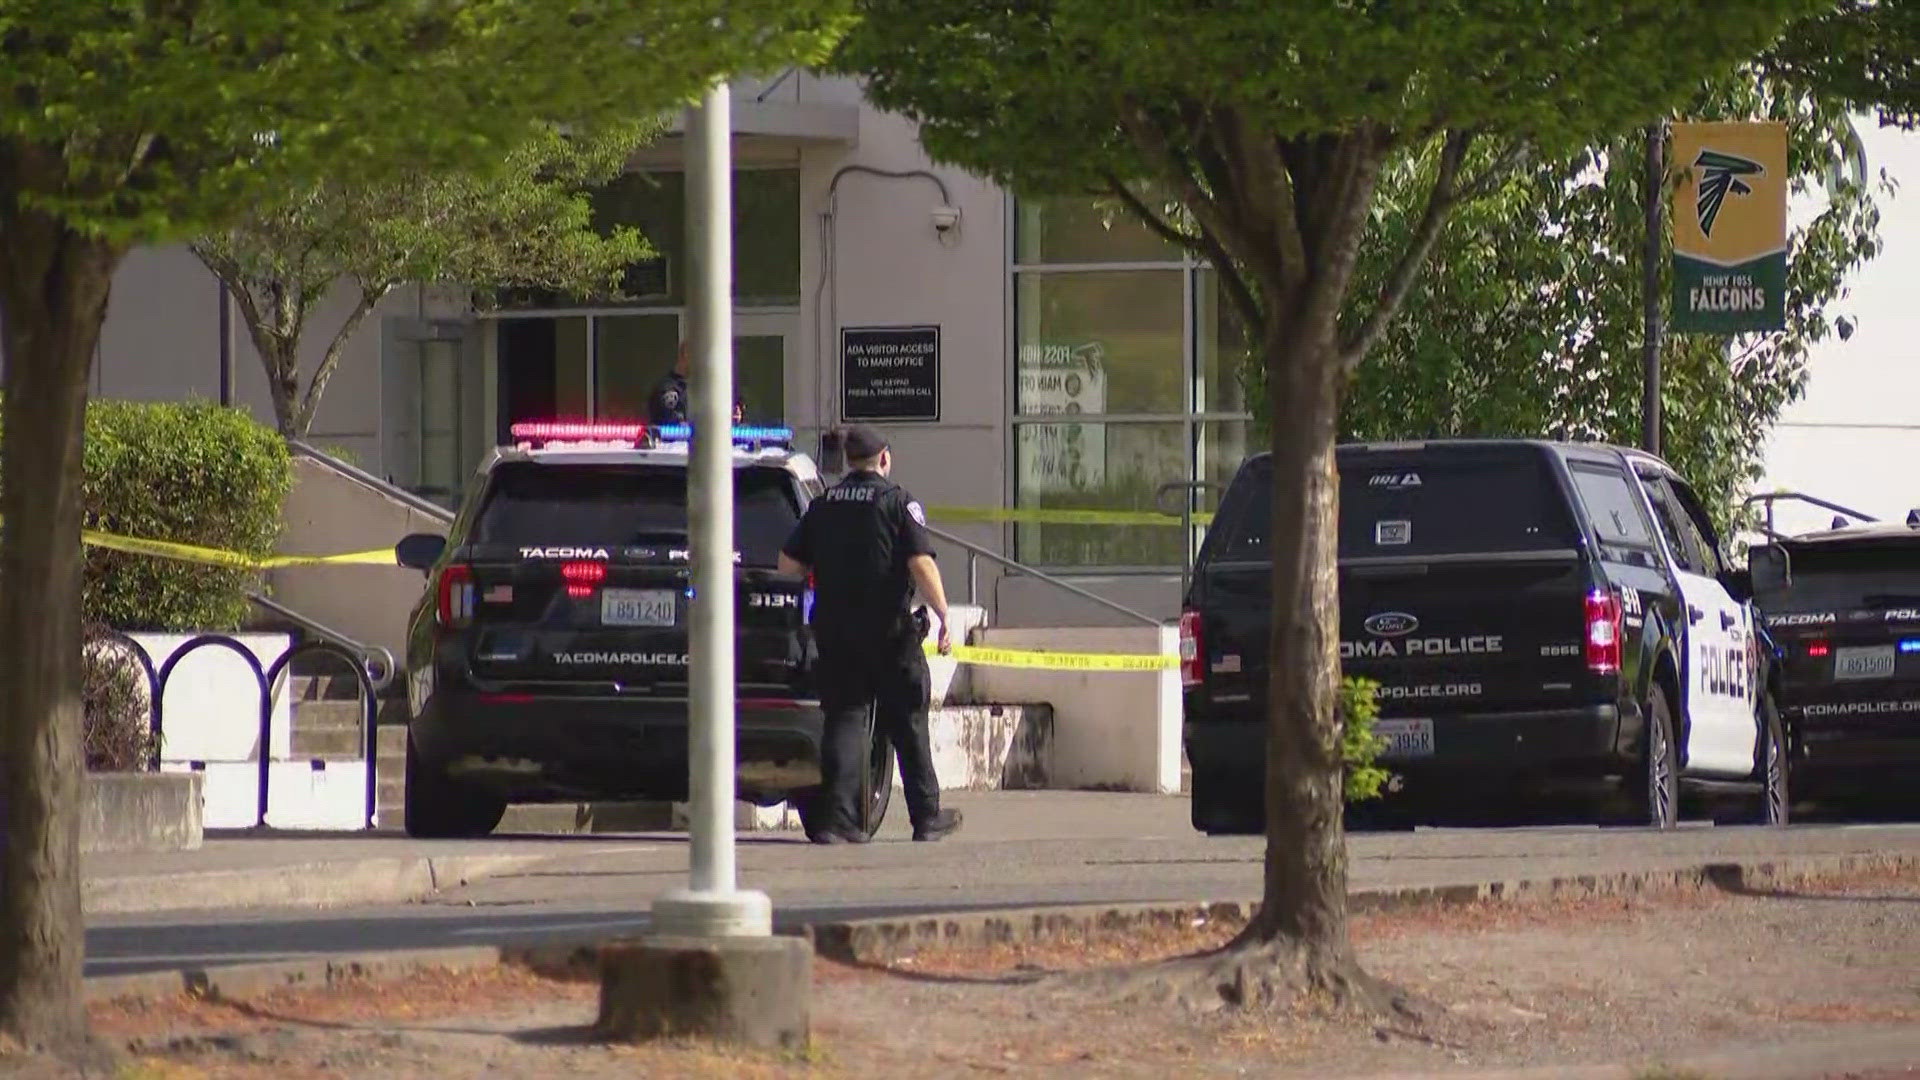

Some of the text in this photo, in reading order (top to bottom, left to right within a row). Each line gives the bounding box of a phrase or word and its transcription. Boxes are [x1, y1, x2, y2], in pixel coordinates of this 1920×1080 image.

[1703, 275, 1753, 287] HENRY FOSS
[1690, 287, 1765, 312] FALCONS
[847, 342, 934, 355] ADA VISITOR ACCESS
[858, 356, 924, 367] TO MAIN OFFICE
[915, 387, 931, 396] CALL
[826, 487, 875, 501] POLICE
[519, 547, 610, 560] TACOMA
[749, 593, 799, 608] 3134
[1768, 612, 1837, 626] TACOMA
[1405, 635, 1503, 655] POLICE
[1700, 644, 1744, 698] POLICE
